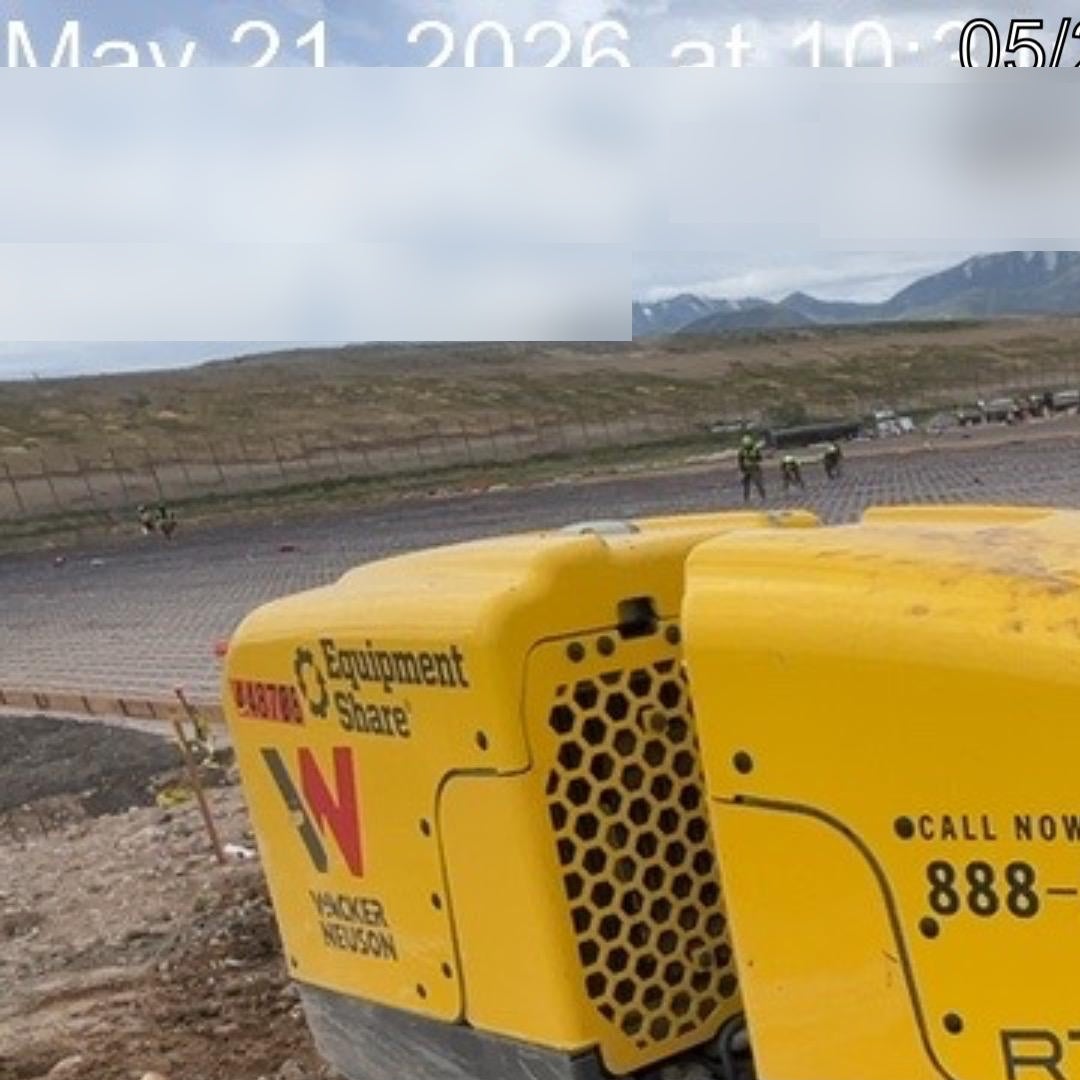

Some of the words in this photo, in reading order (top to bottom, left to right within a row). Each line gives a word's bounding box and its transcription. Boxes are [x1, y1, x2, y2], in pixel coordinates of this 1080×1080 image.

[318, 638, 469, 693] Equipment
[333, 690, 411, 738] Share
[919, 814, 997, 842] CALL
